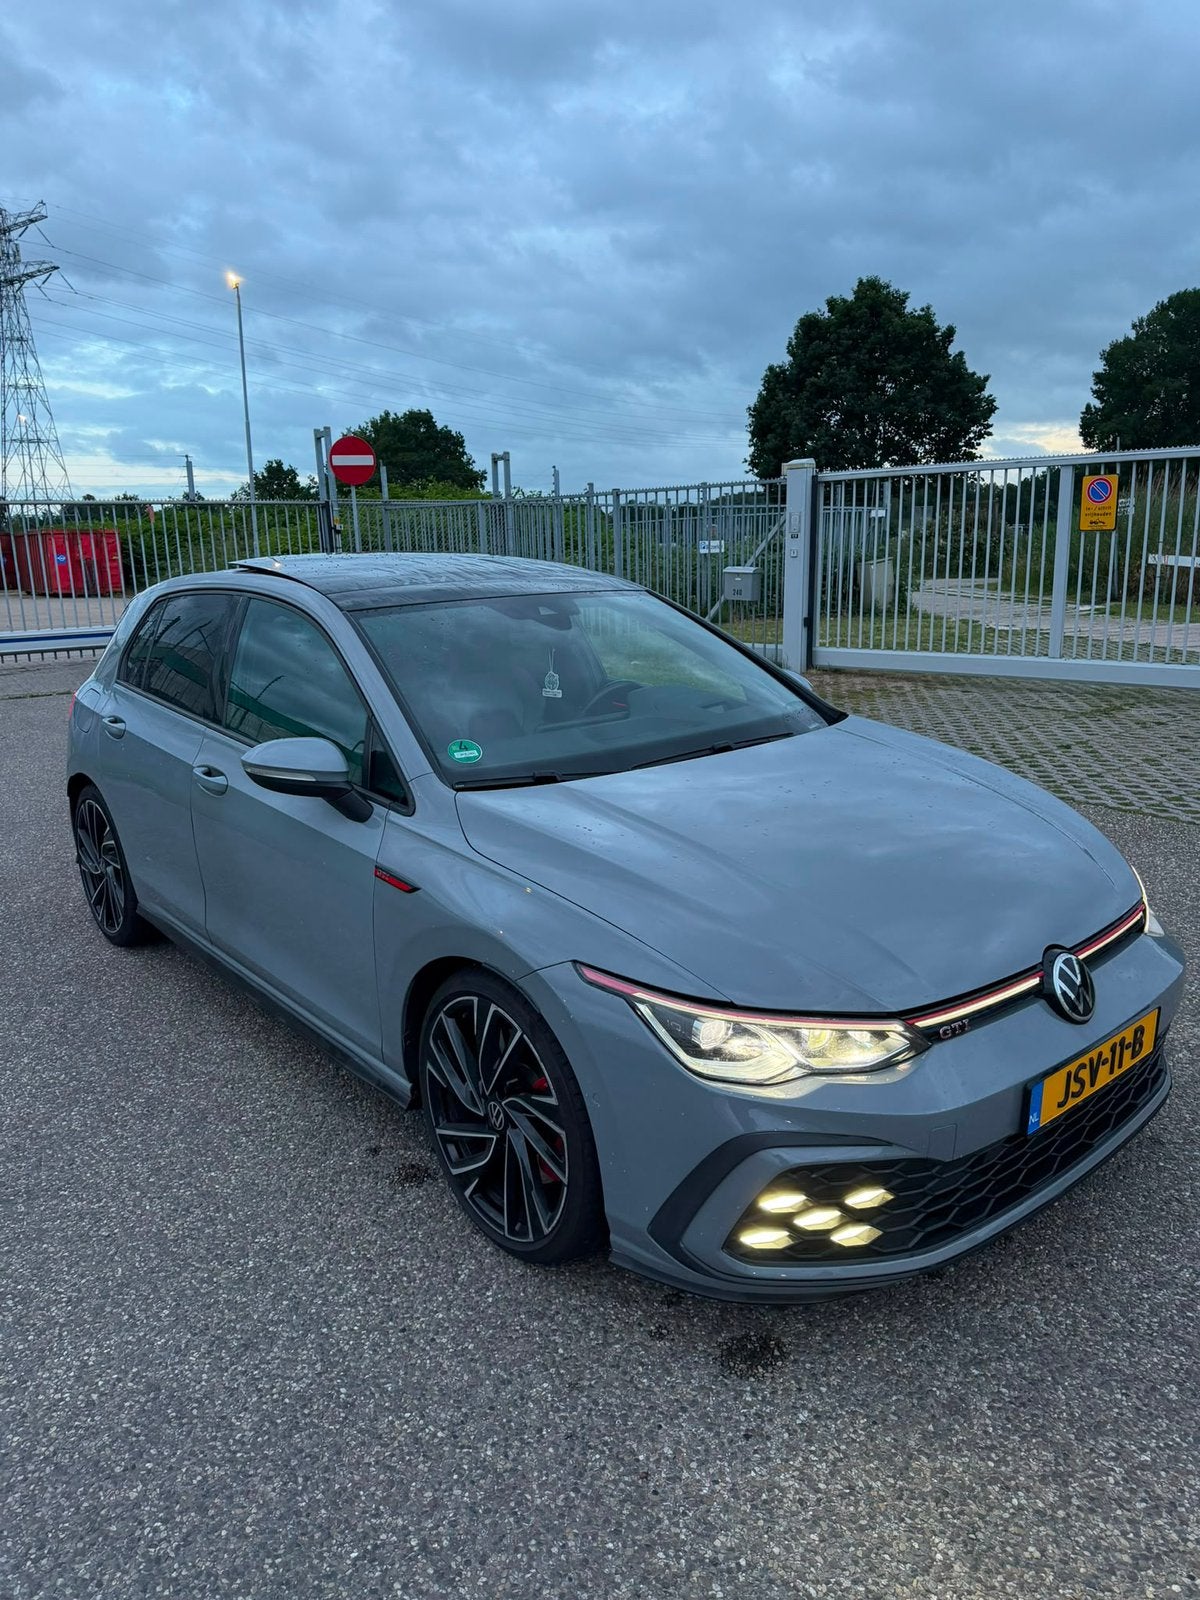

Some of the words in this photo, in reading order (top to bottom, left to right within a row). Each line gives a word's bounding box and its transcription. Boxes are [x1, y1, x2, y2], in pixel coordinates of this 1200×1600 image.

[459, 740, 468, 751] 4
[940, 1019, 969, 1039] GTI
[1057, 1024, 1146, 1109] JSV-11-B
[1028, 1111, 1040, 1126] NL
